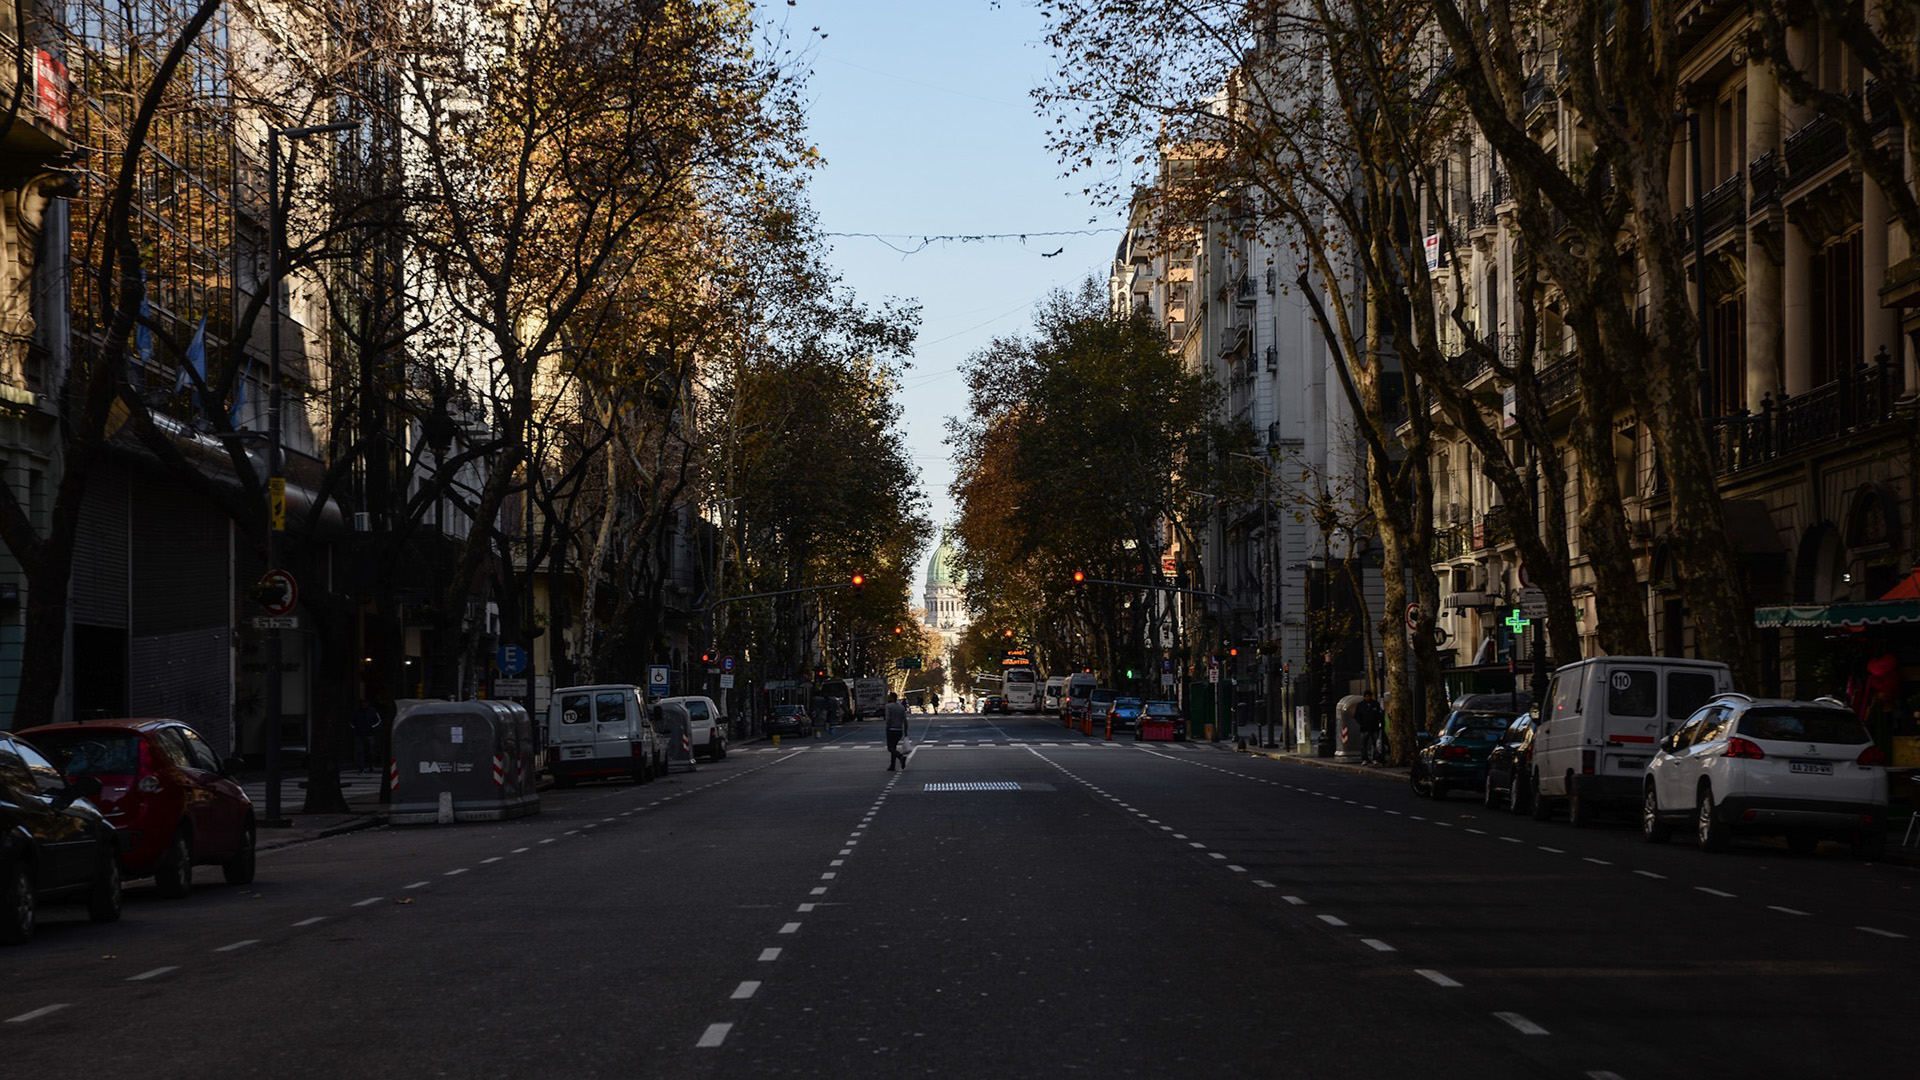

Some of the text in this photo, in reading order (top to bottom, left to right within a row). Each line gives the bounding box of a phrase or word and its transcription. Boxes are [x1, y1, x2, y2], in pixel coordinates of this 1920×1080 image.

[505, 646, 517, 662] E
[725, 658, 733, 670] E
[1614, 675, 1630, 688] 110
[565, 711, 578, 721] 110
[419, 761, 441, 774] BA
